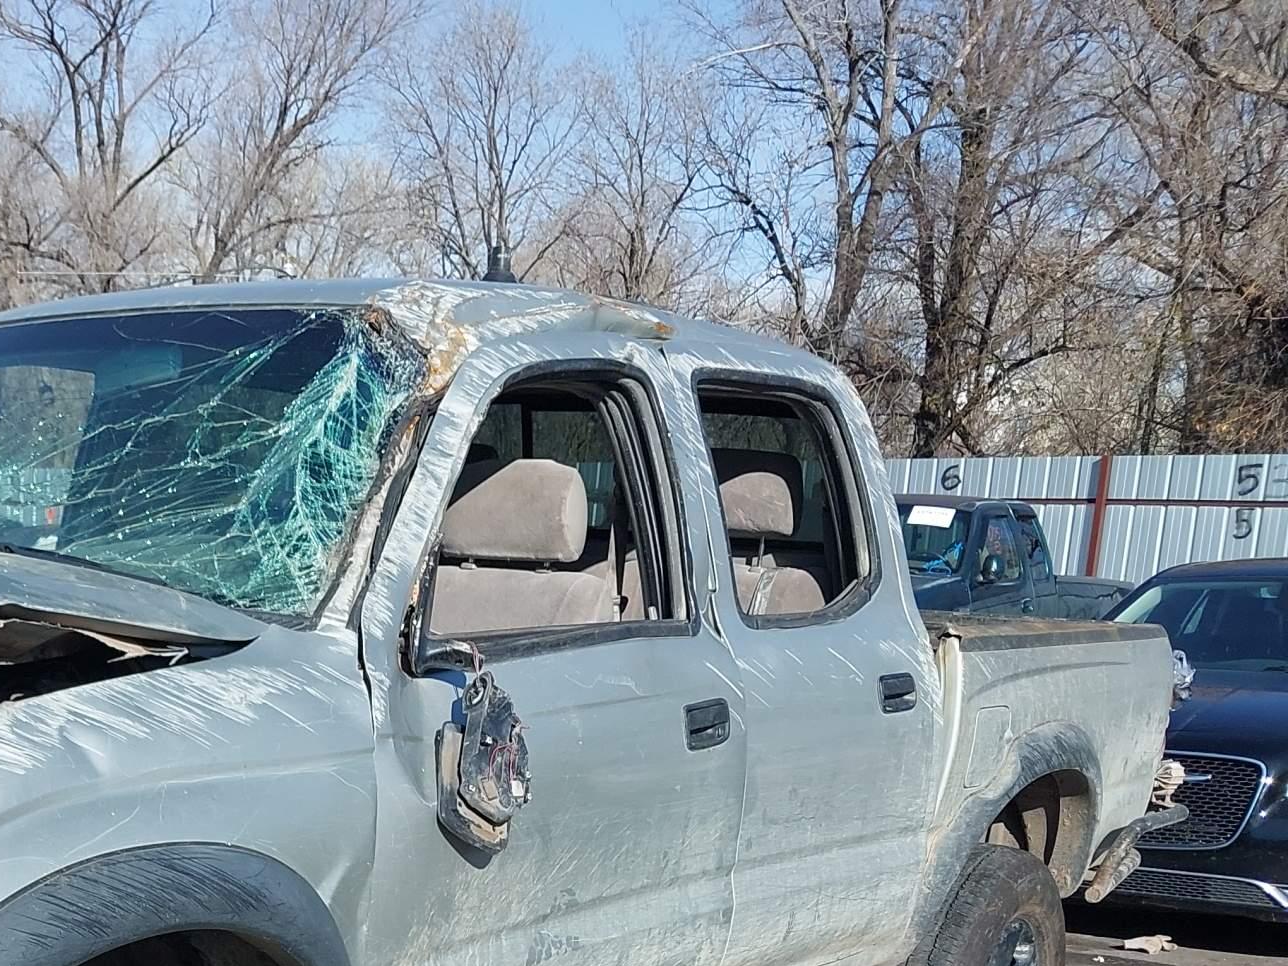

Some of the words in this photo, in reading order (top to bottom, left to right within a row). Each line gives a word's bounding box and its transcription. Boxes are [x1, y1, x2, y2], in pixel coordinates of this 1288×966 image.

[941, 464, 961, 491] 6
[1238, 464, 1263, 496] 5
[1233, 508, 1255, 539] 5
